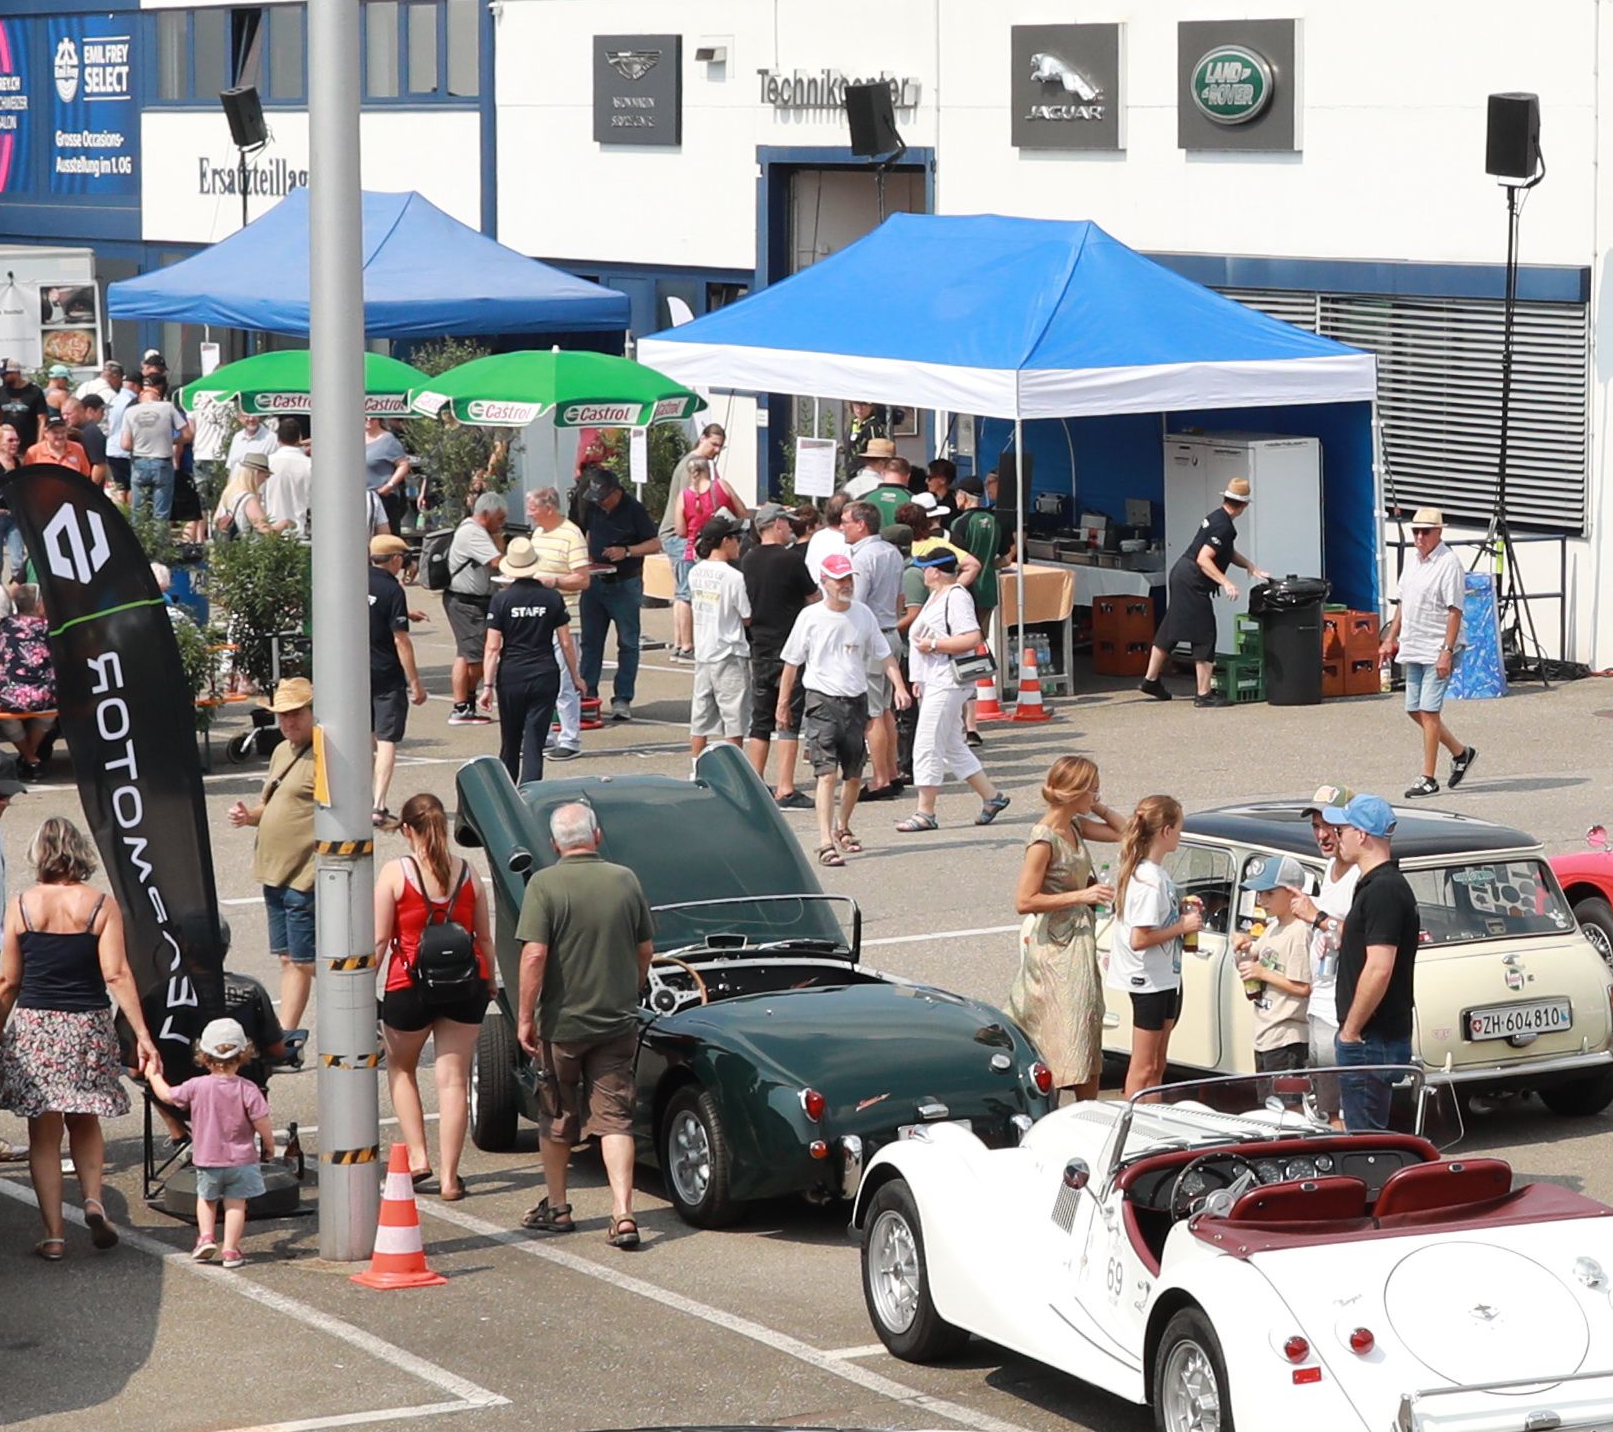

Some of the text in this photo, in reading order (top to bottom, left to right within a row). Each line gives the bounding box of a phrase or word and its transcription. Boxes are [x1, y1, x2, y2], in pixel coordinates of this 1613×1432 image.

[84, 44, 129, 65] EMIL FREY
[84, 66, 129, 93] SELECT
[1205, 61, 1243, 83] LAND
[1208, 84, 1254, 106] ROVER
[1024, 105, 1105, 120] JAGUAR
[55, 130, 82, 147] Grosse
[118, 157, 132, 174] OG
[486, 403, 532, 421] Castrol
[579, 404, 631, 421] Castrol
[511, 607, 547, 618] STAFF
[1108, 1257, 1123, 1296] 69
